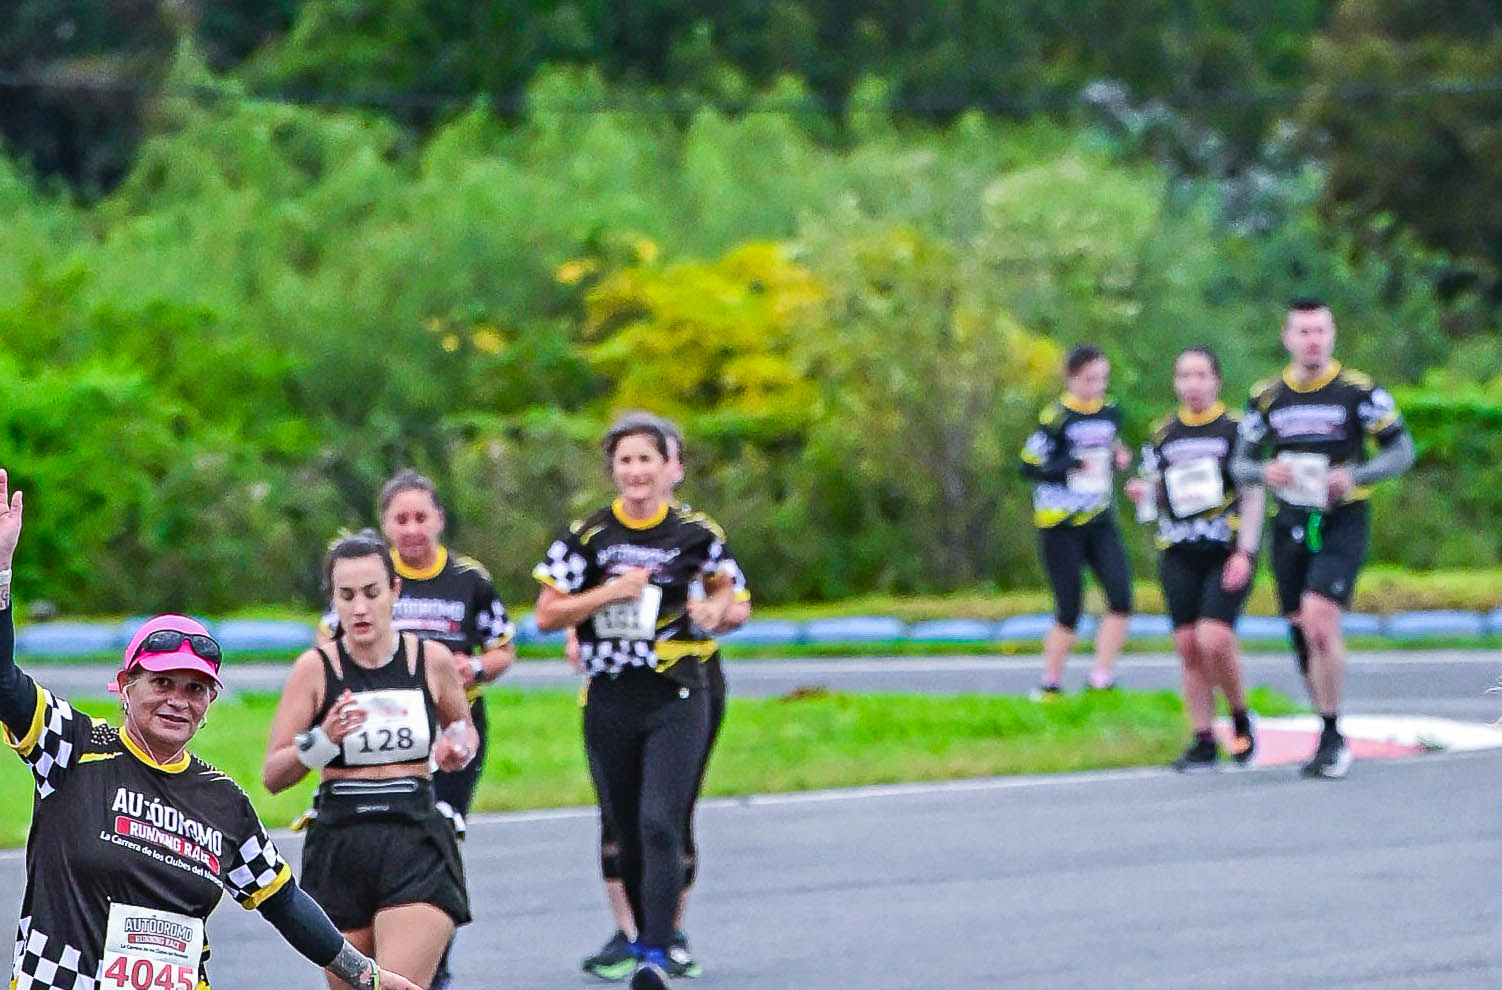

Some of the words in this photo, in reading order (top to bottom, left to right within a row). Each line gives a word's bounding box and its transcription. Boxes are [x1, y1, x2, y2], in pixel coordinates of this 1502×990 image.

[358, 727, 414, 753] 128
[100, 831, 110, 841] La
[112, 835, 141, 852] Carrera
[141, 846, 152, 857] de
[152, 850, 164, 862] los
[165, 856, 191, 872] Clubes
[124, 914, 194, 942] AUTÓDROMO
